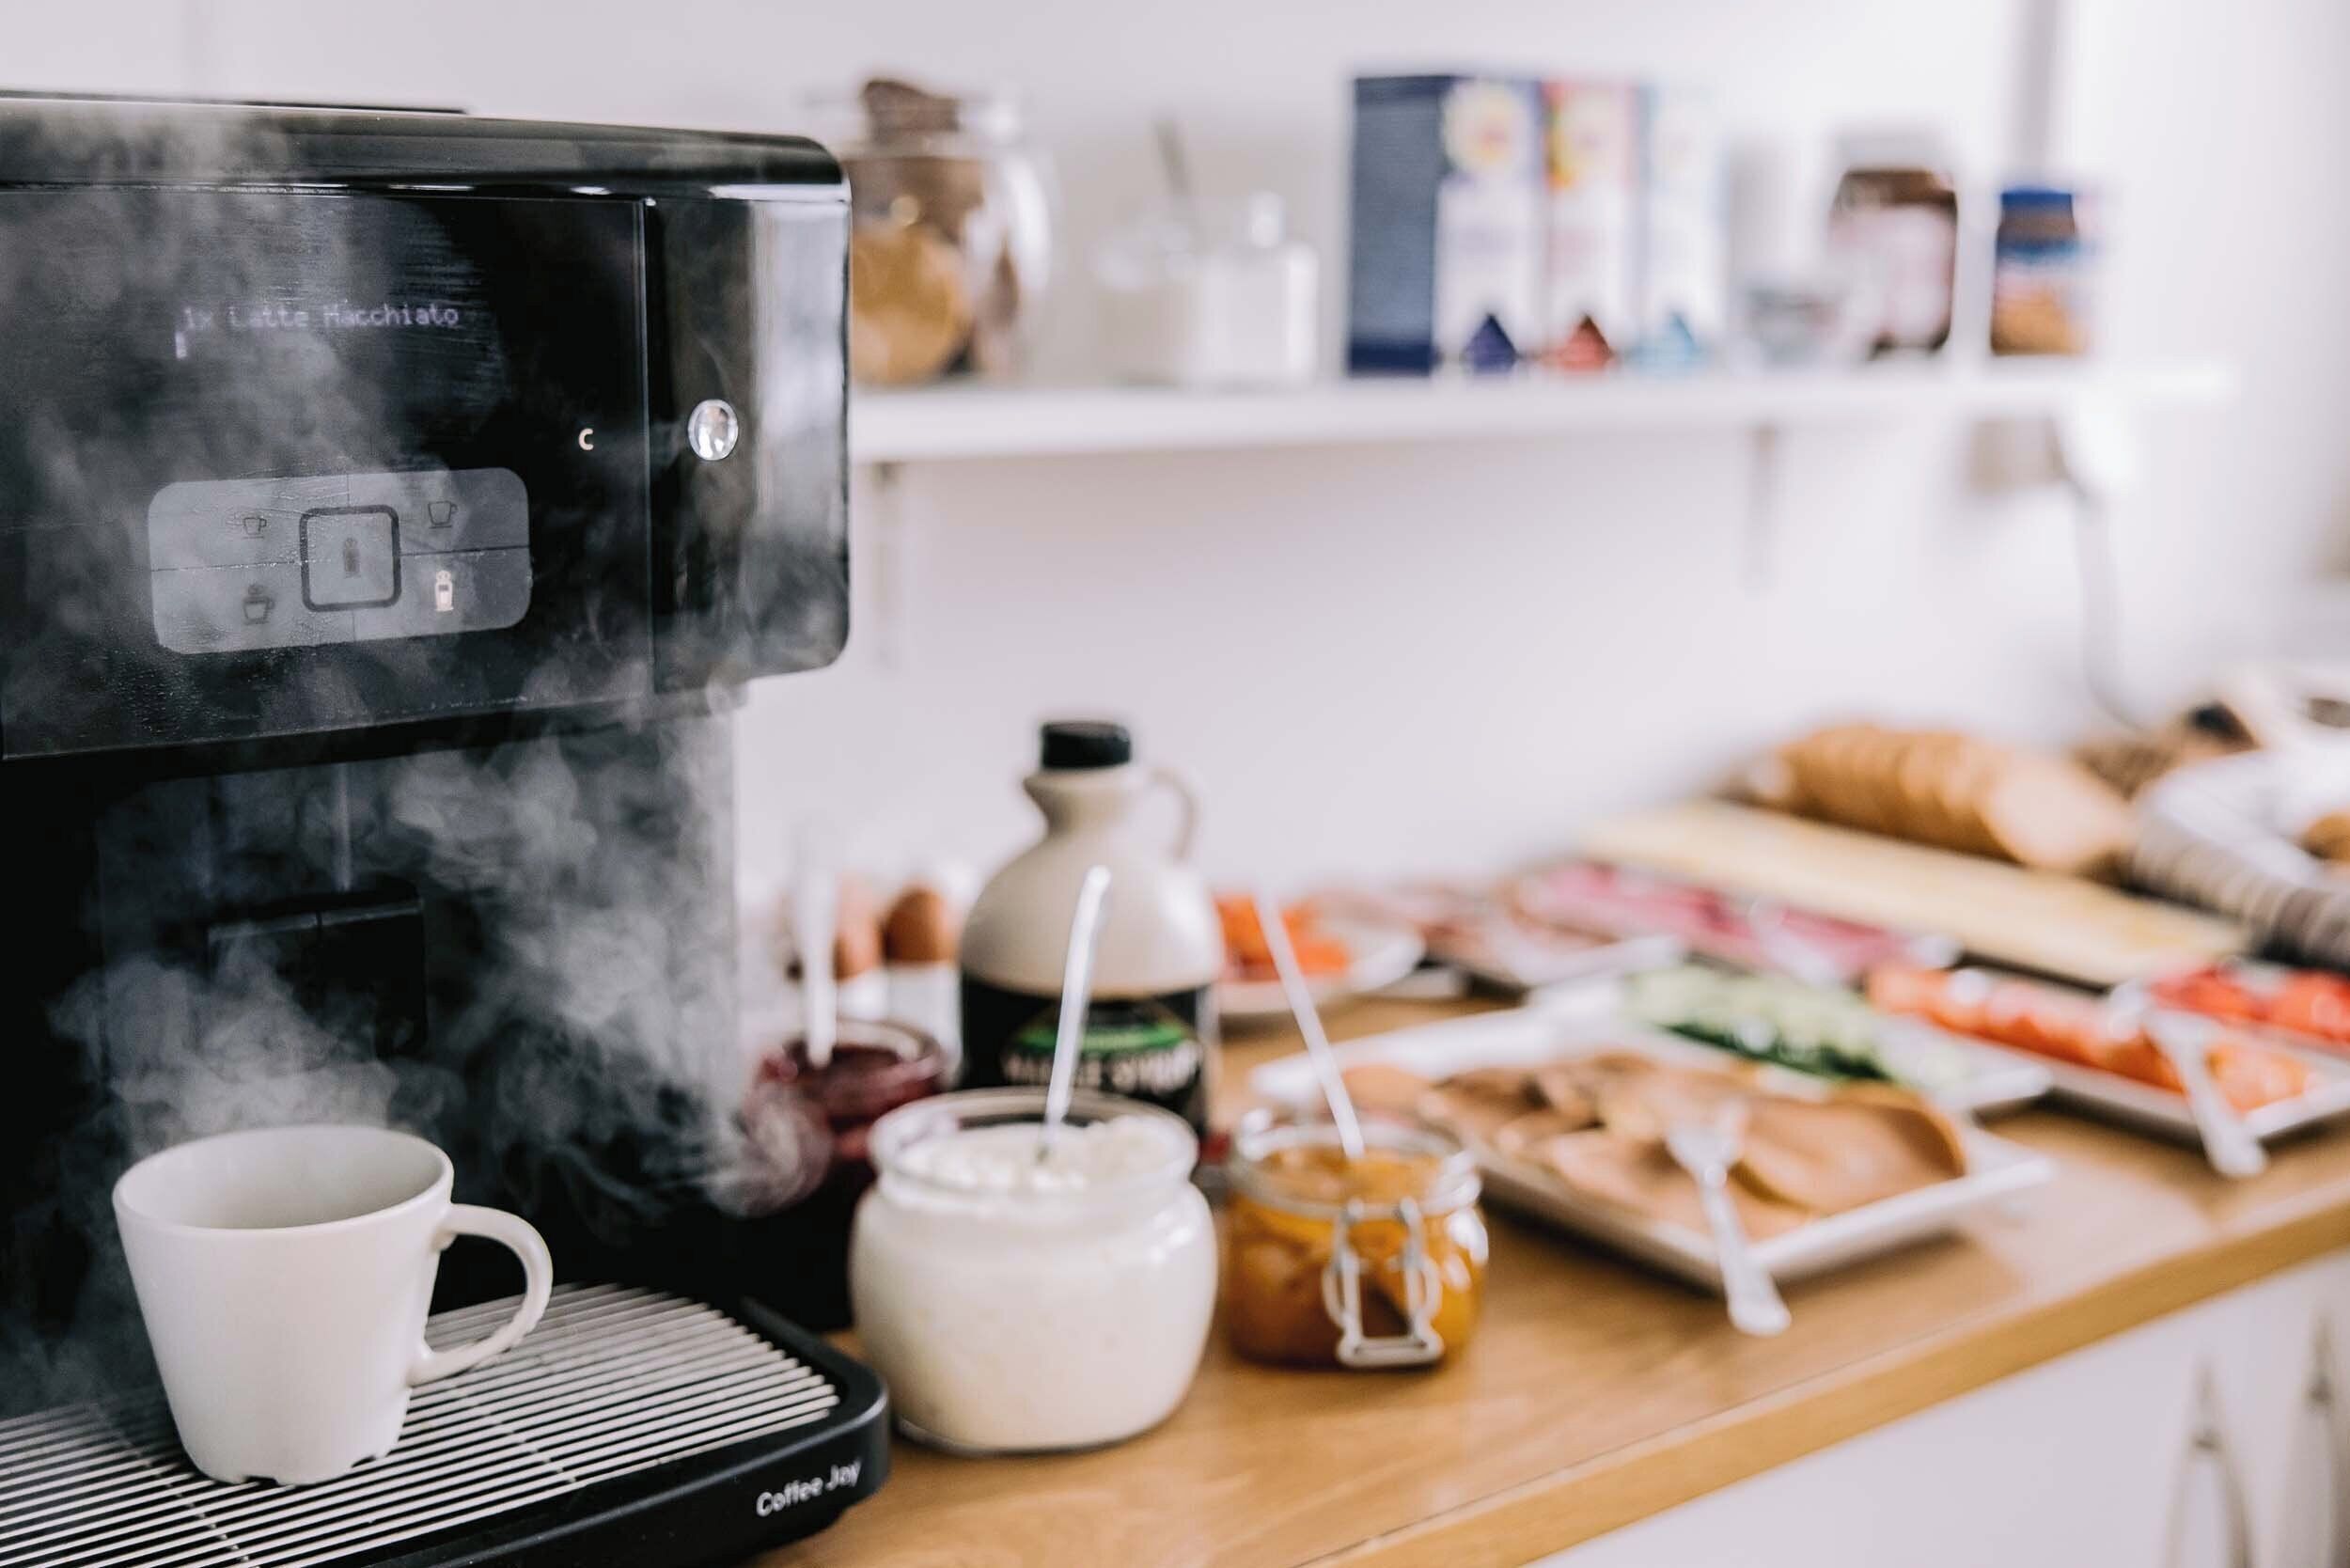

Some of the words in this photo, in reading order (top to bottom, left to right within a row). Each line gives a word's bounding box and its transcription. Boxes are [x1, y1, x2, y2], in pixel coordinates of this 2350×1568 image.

[226, 303, 309, 329] Latte
[322, 302, 460, 327] Macchiato
[578, 428, 594, 451] C
[755, 1477, 824, 1517] Coffee
[825, 1458, 862, 1491] Joy
